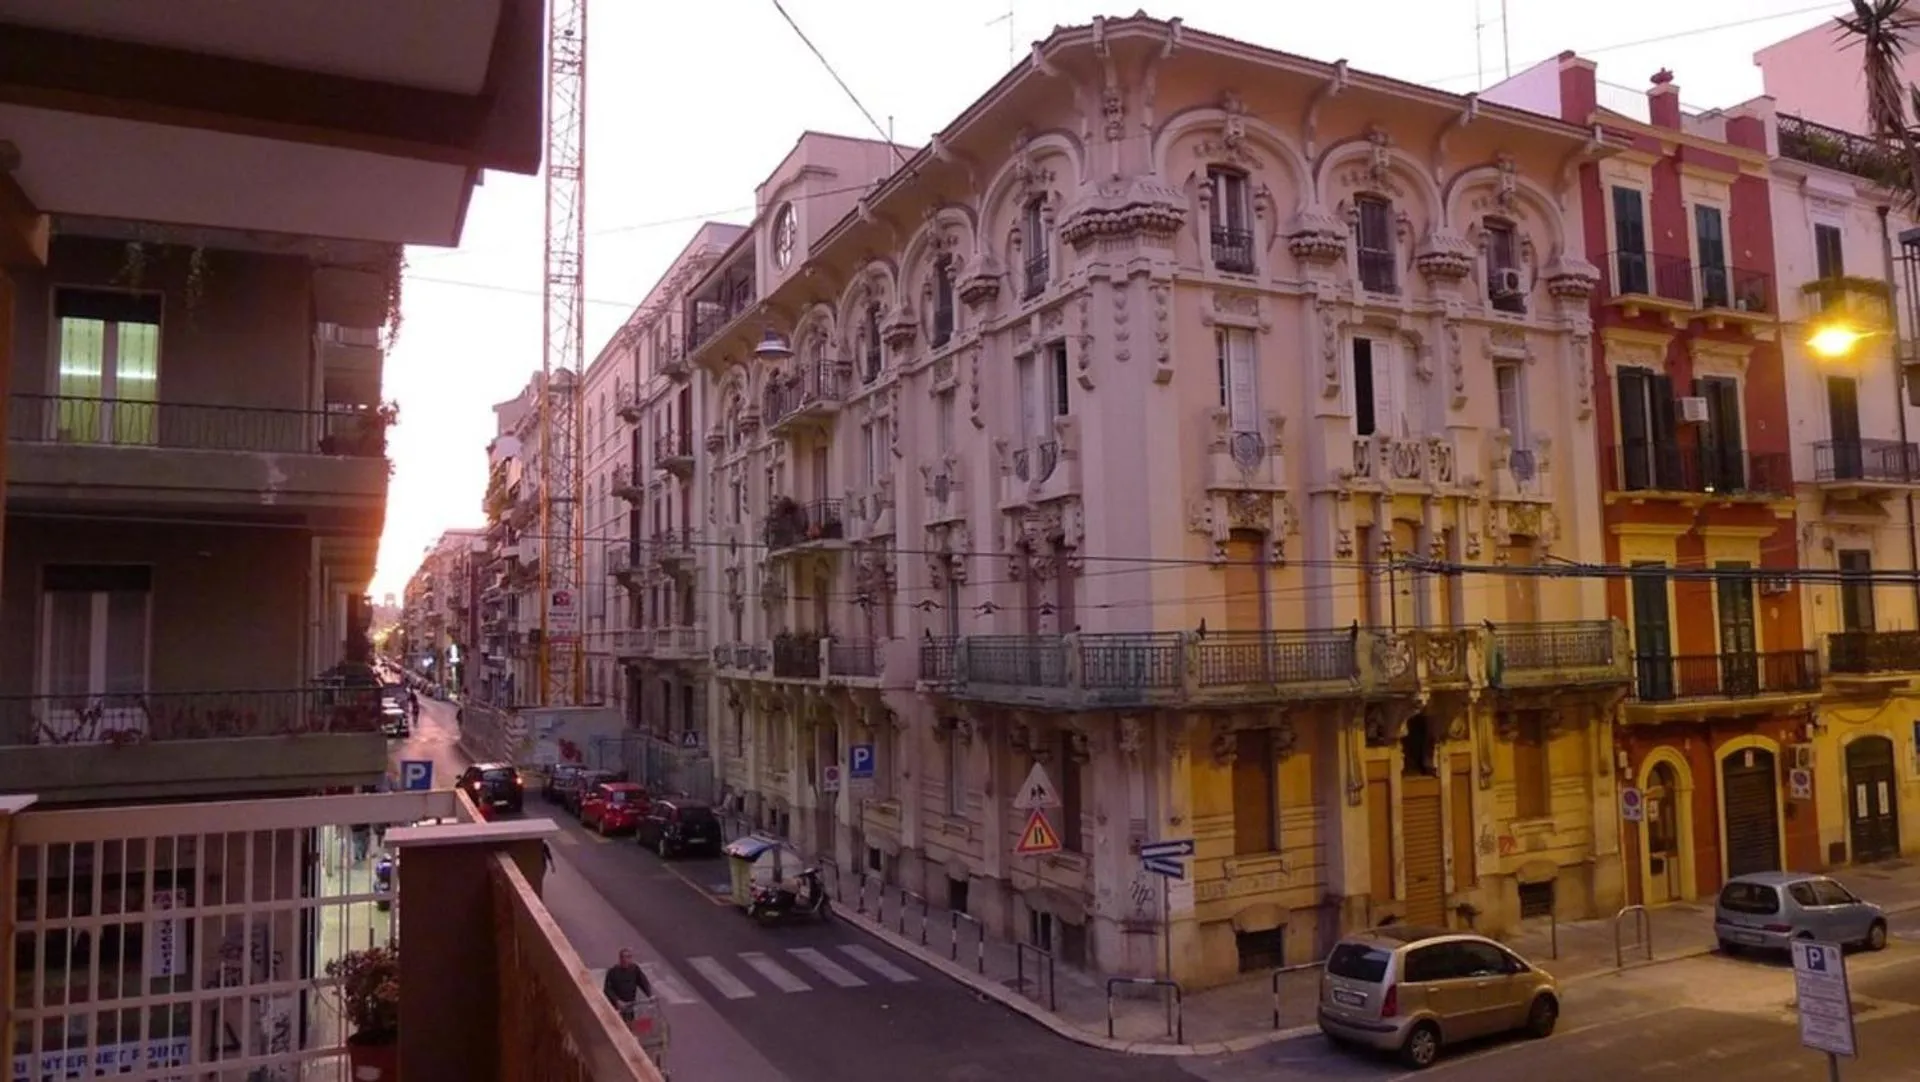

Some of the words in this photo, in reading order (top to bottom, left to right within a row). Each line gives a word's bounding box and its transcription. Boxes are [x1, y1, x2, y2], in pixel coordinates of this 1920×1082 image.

[854, 748, 869, 769] P
[406, 763, 426, 789] P
[1808, 948, 1821, 969] P
[36, 1049, 127, 1071] NTERNET
